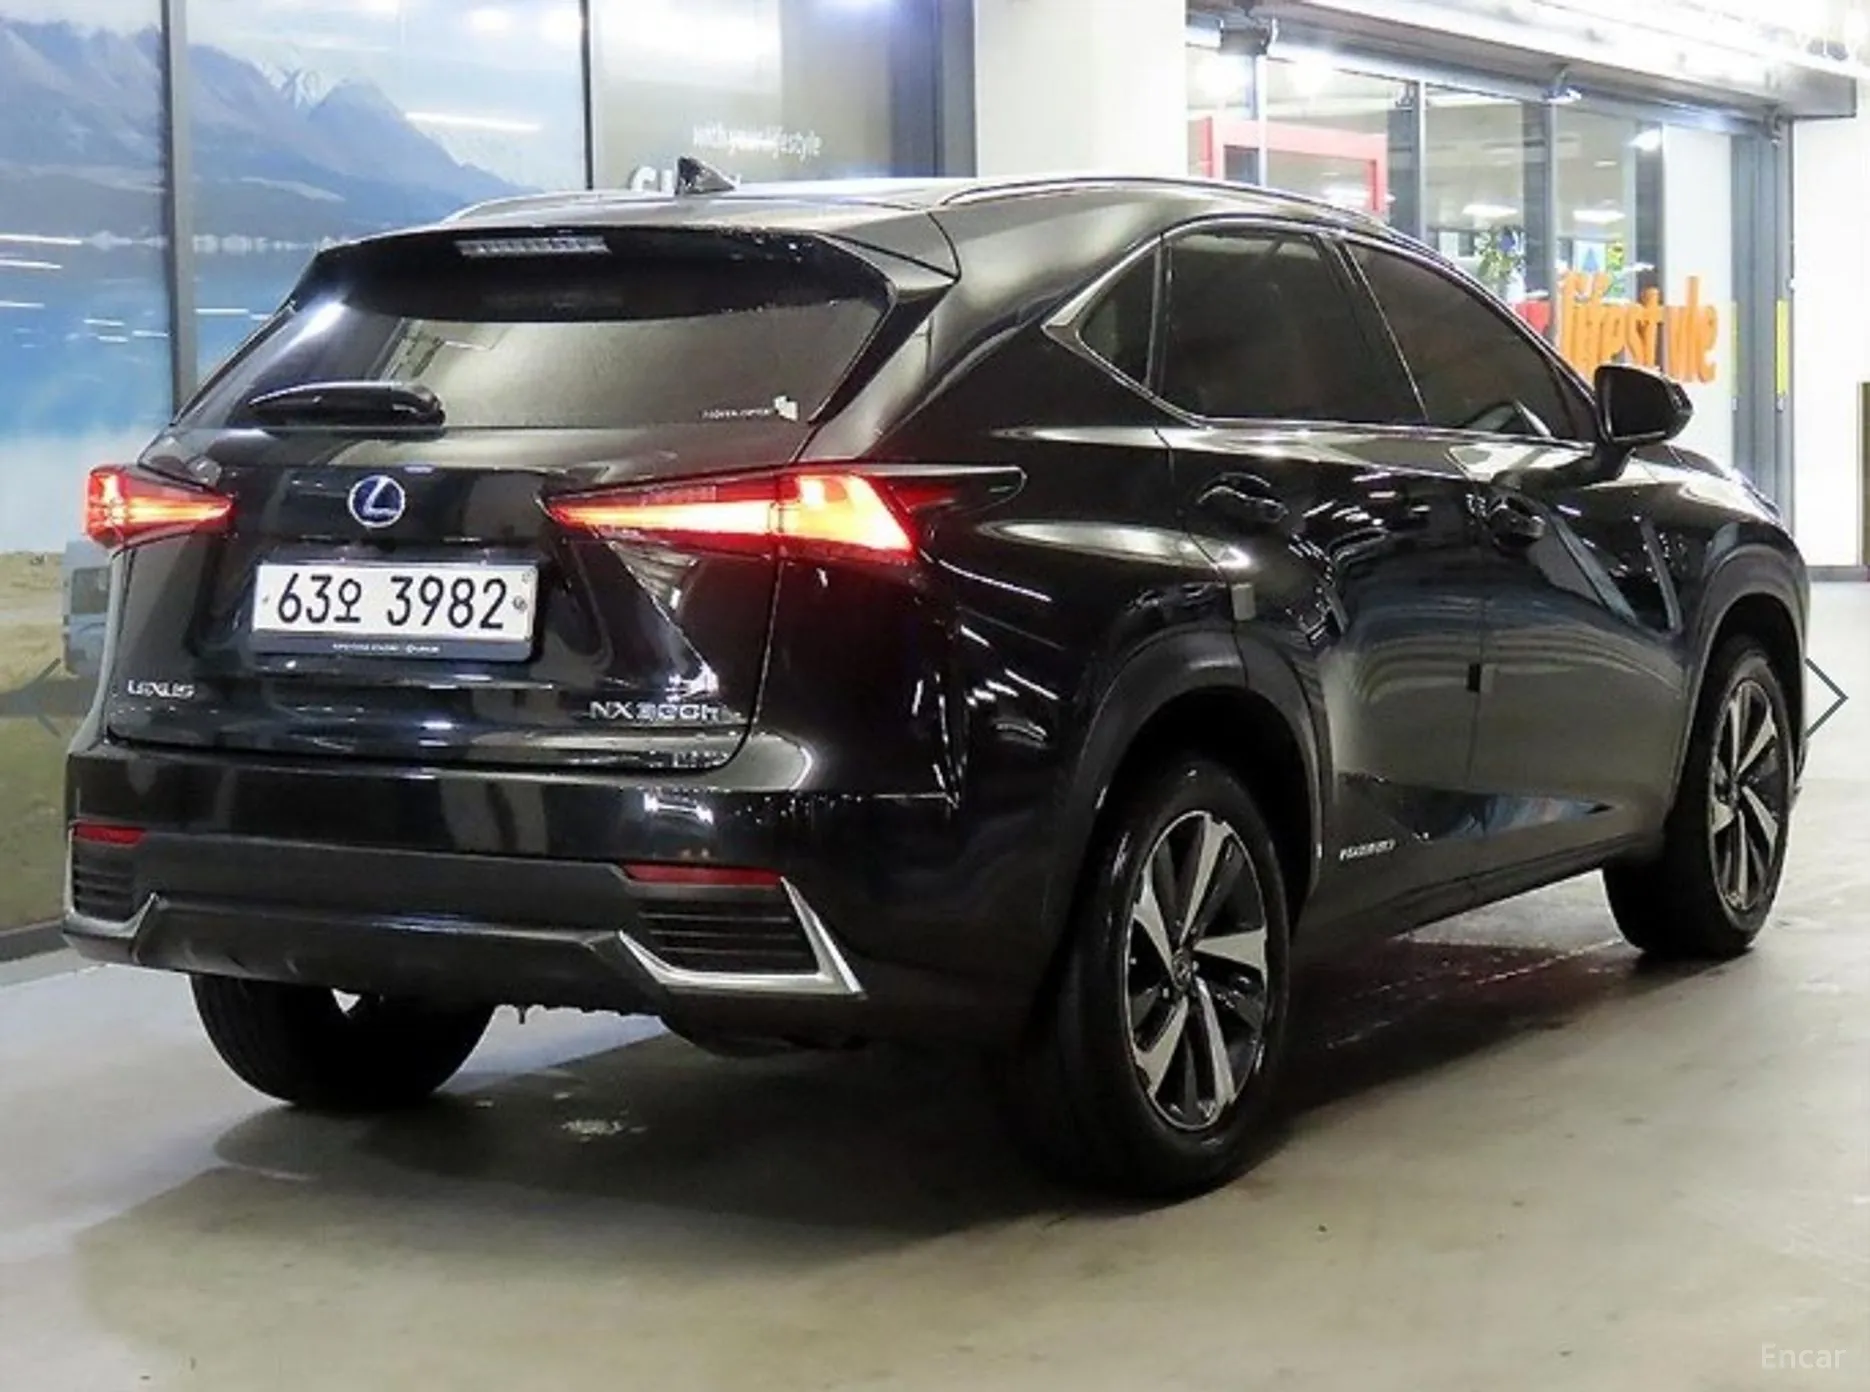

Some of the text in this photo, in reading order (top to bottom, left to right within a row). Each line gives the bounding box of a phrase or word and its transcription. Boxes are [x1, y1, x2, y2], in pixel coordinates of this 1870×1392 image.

[278, 573, 507, 629] 63오 3982
[127, 680, 194, 699] LEXUS
